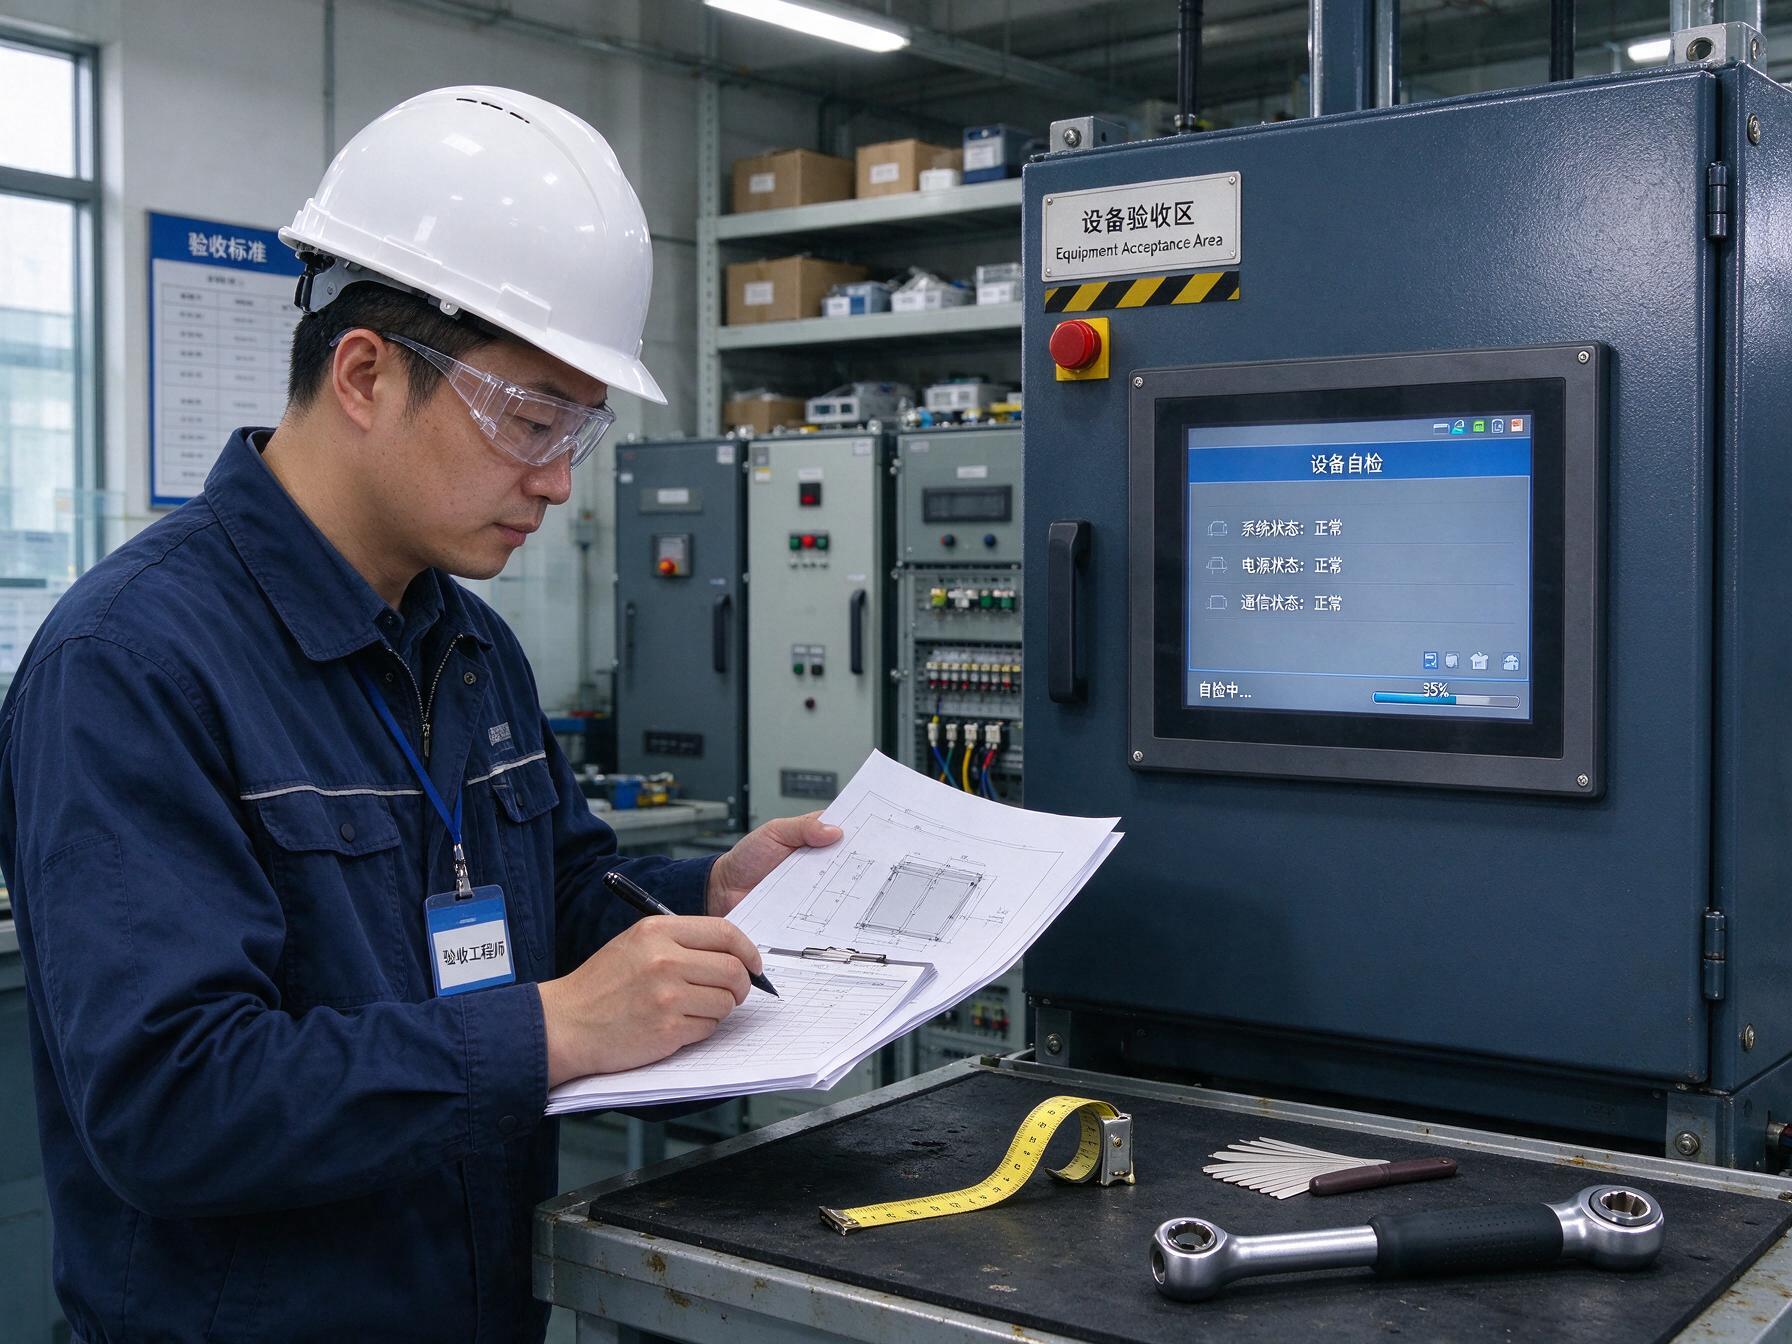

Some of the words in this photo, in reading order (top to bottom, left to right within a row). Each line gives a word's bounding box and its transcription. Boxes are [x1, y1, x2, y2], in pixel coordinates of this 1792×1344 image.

[1082, 200, 1195, 234] 设备验收区
[188, 232, 267, 263] 验收标准
[1056, 243, 1119, 264] Equipment
[1121, 238, 1191, 256] Acceptance
[1192, 233, 1223, 249] Area
[1311, 452, 1383, 475] 设备自检
[443, 941, 505, 965] 验收工程师
